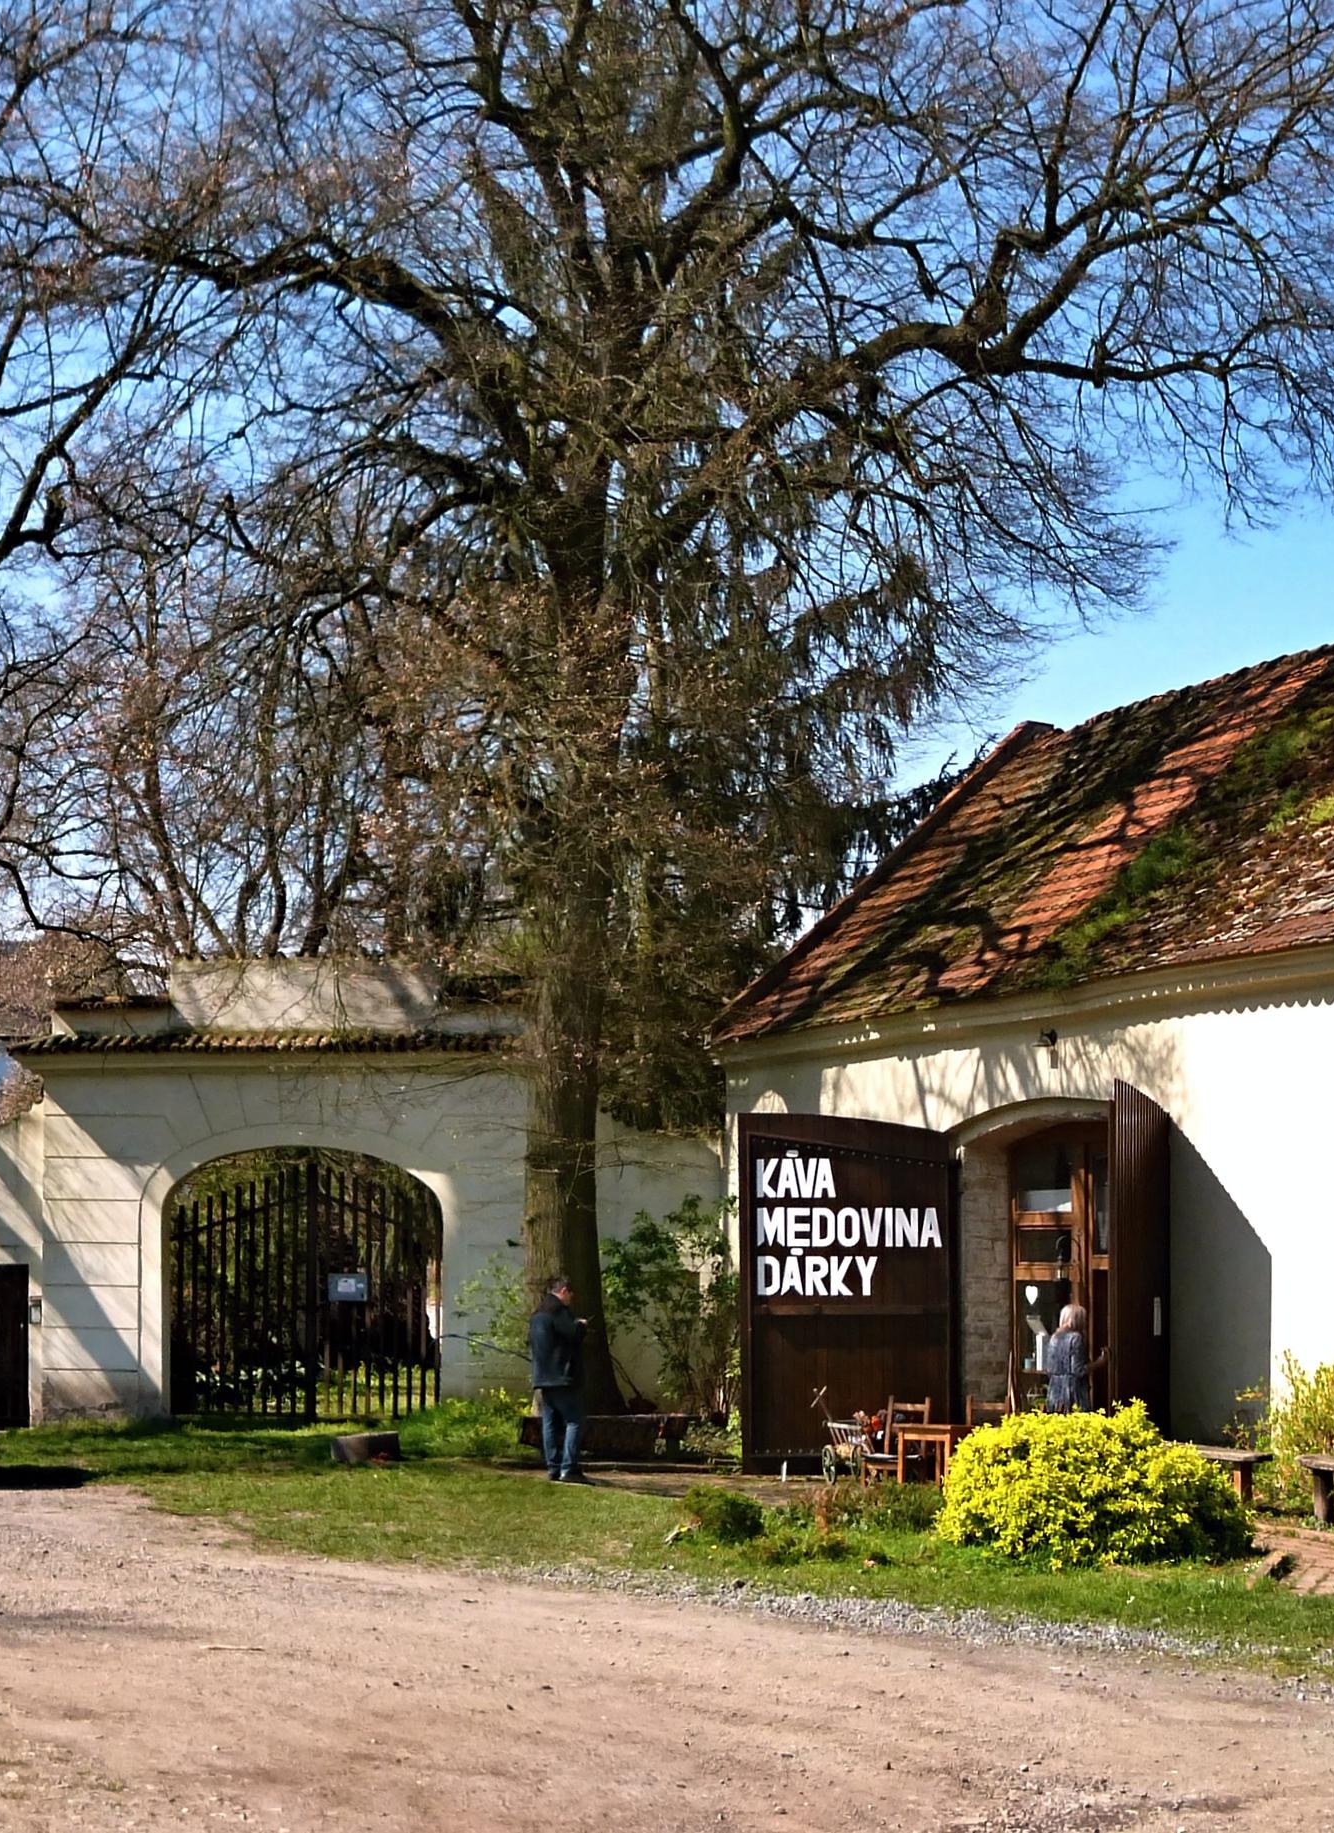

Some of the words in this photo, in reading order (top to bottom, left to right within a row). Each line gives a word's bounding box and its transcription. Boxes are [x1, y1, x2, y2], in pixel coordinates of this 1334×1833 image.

[756, 1149, 837, 1199] KÁVA
[756, 1206, 943, 1248] MEDOVINA
[756, 1248, 878, 1297] DÁRKY
